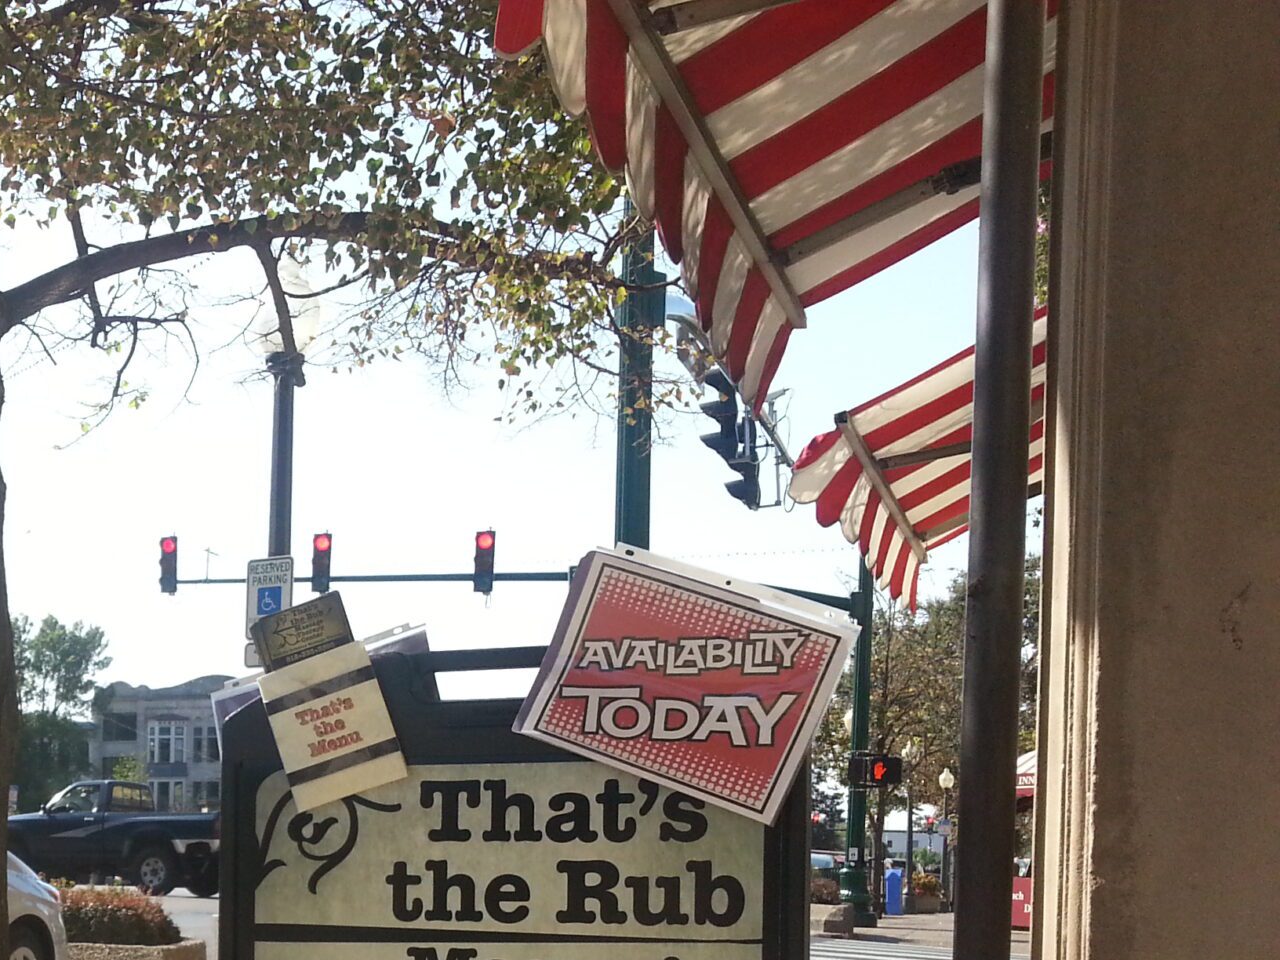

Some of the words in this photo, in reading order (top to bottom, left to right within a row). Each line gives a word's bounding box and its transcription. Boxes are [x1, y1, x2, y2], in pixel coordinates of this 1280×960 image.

[249, 561, 290, 575] RESERVED
[252, 574, 288, 586] PARKING
[576, 631, 811, 676] AVAILABILITY
[295, 697, 354, 725] That's
[560, 684, 803, 747] TODAY
[313, 719, 346, 737] the
[307, 731, 364, 757] Menu
[420, 778, 709, 843] That's
[385, 860, 531, 924] the
[555, 860, 745, 927] Rub
